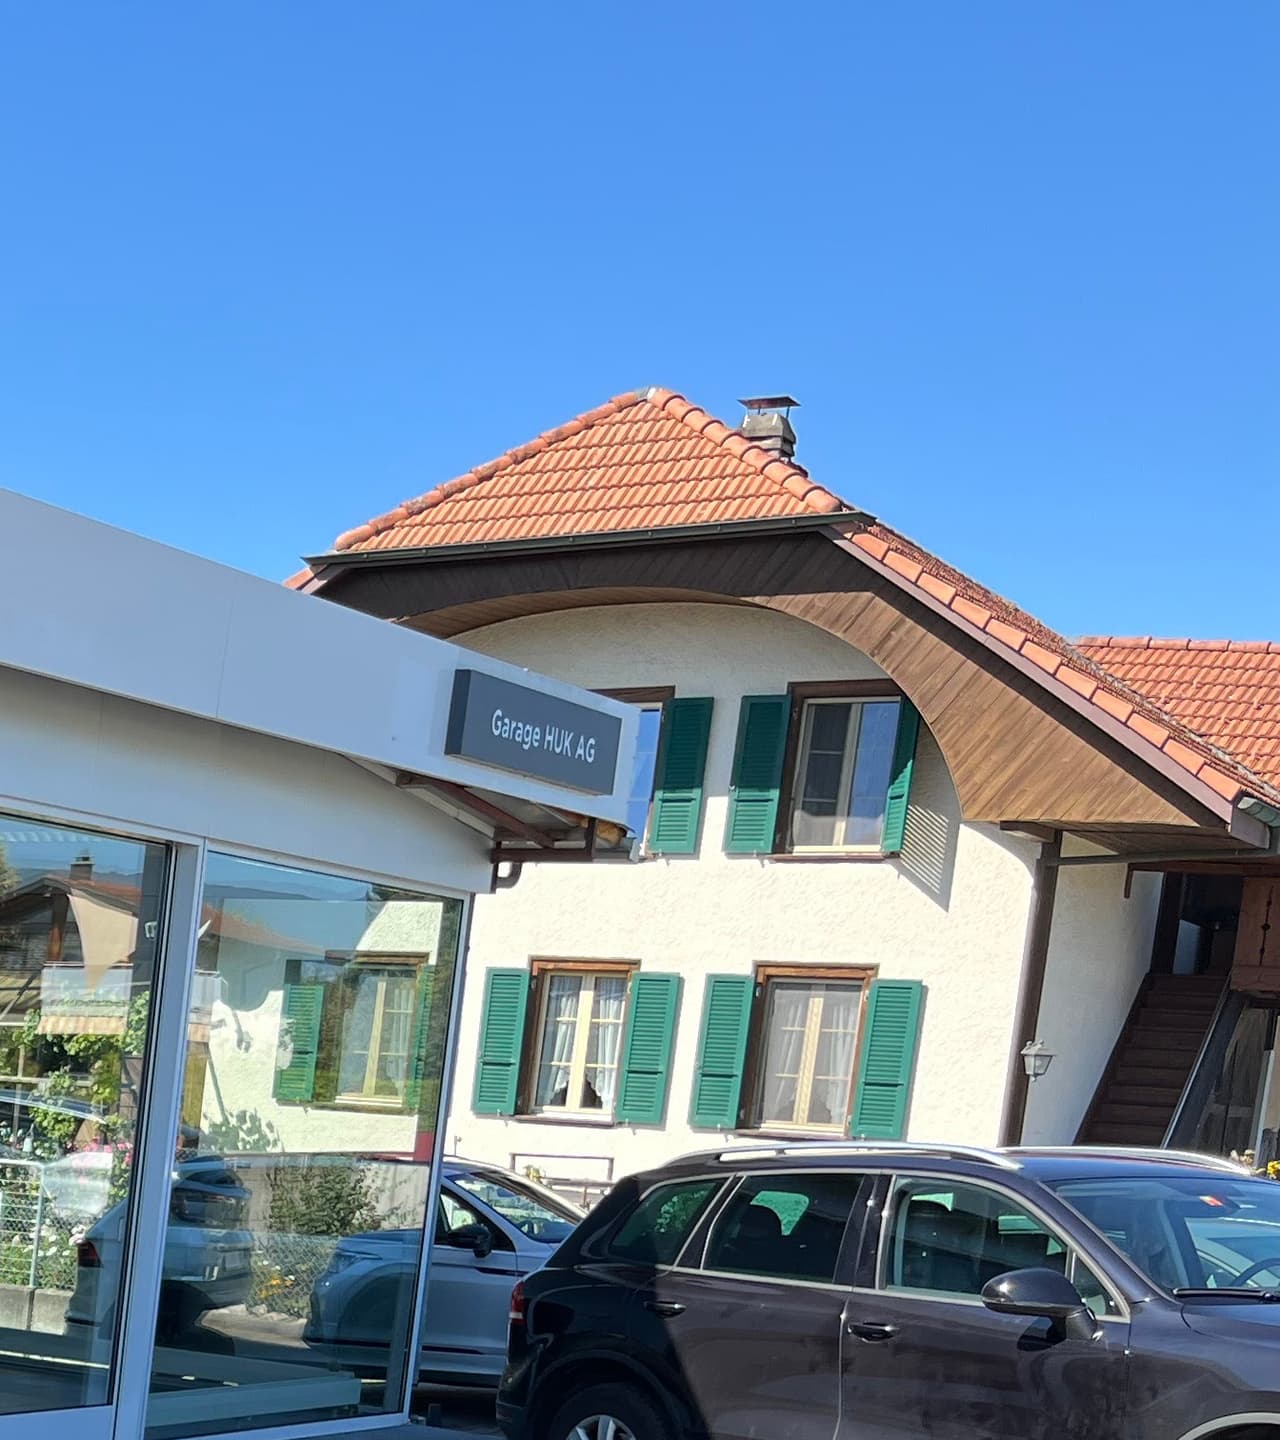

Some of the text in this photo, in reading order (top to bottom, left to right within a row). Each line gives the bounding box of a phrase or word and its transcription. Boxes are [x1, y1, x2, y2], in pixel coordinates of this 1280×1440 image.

[491, 708, 596, 763] Garage HUK AG
